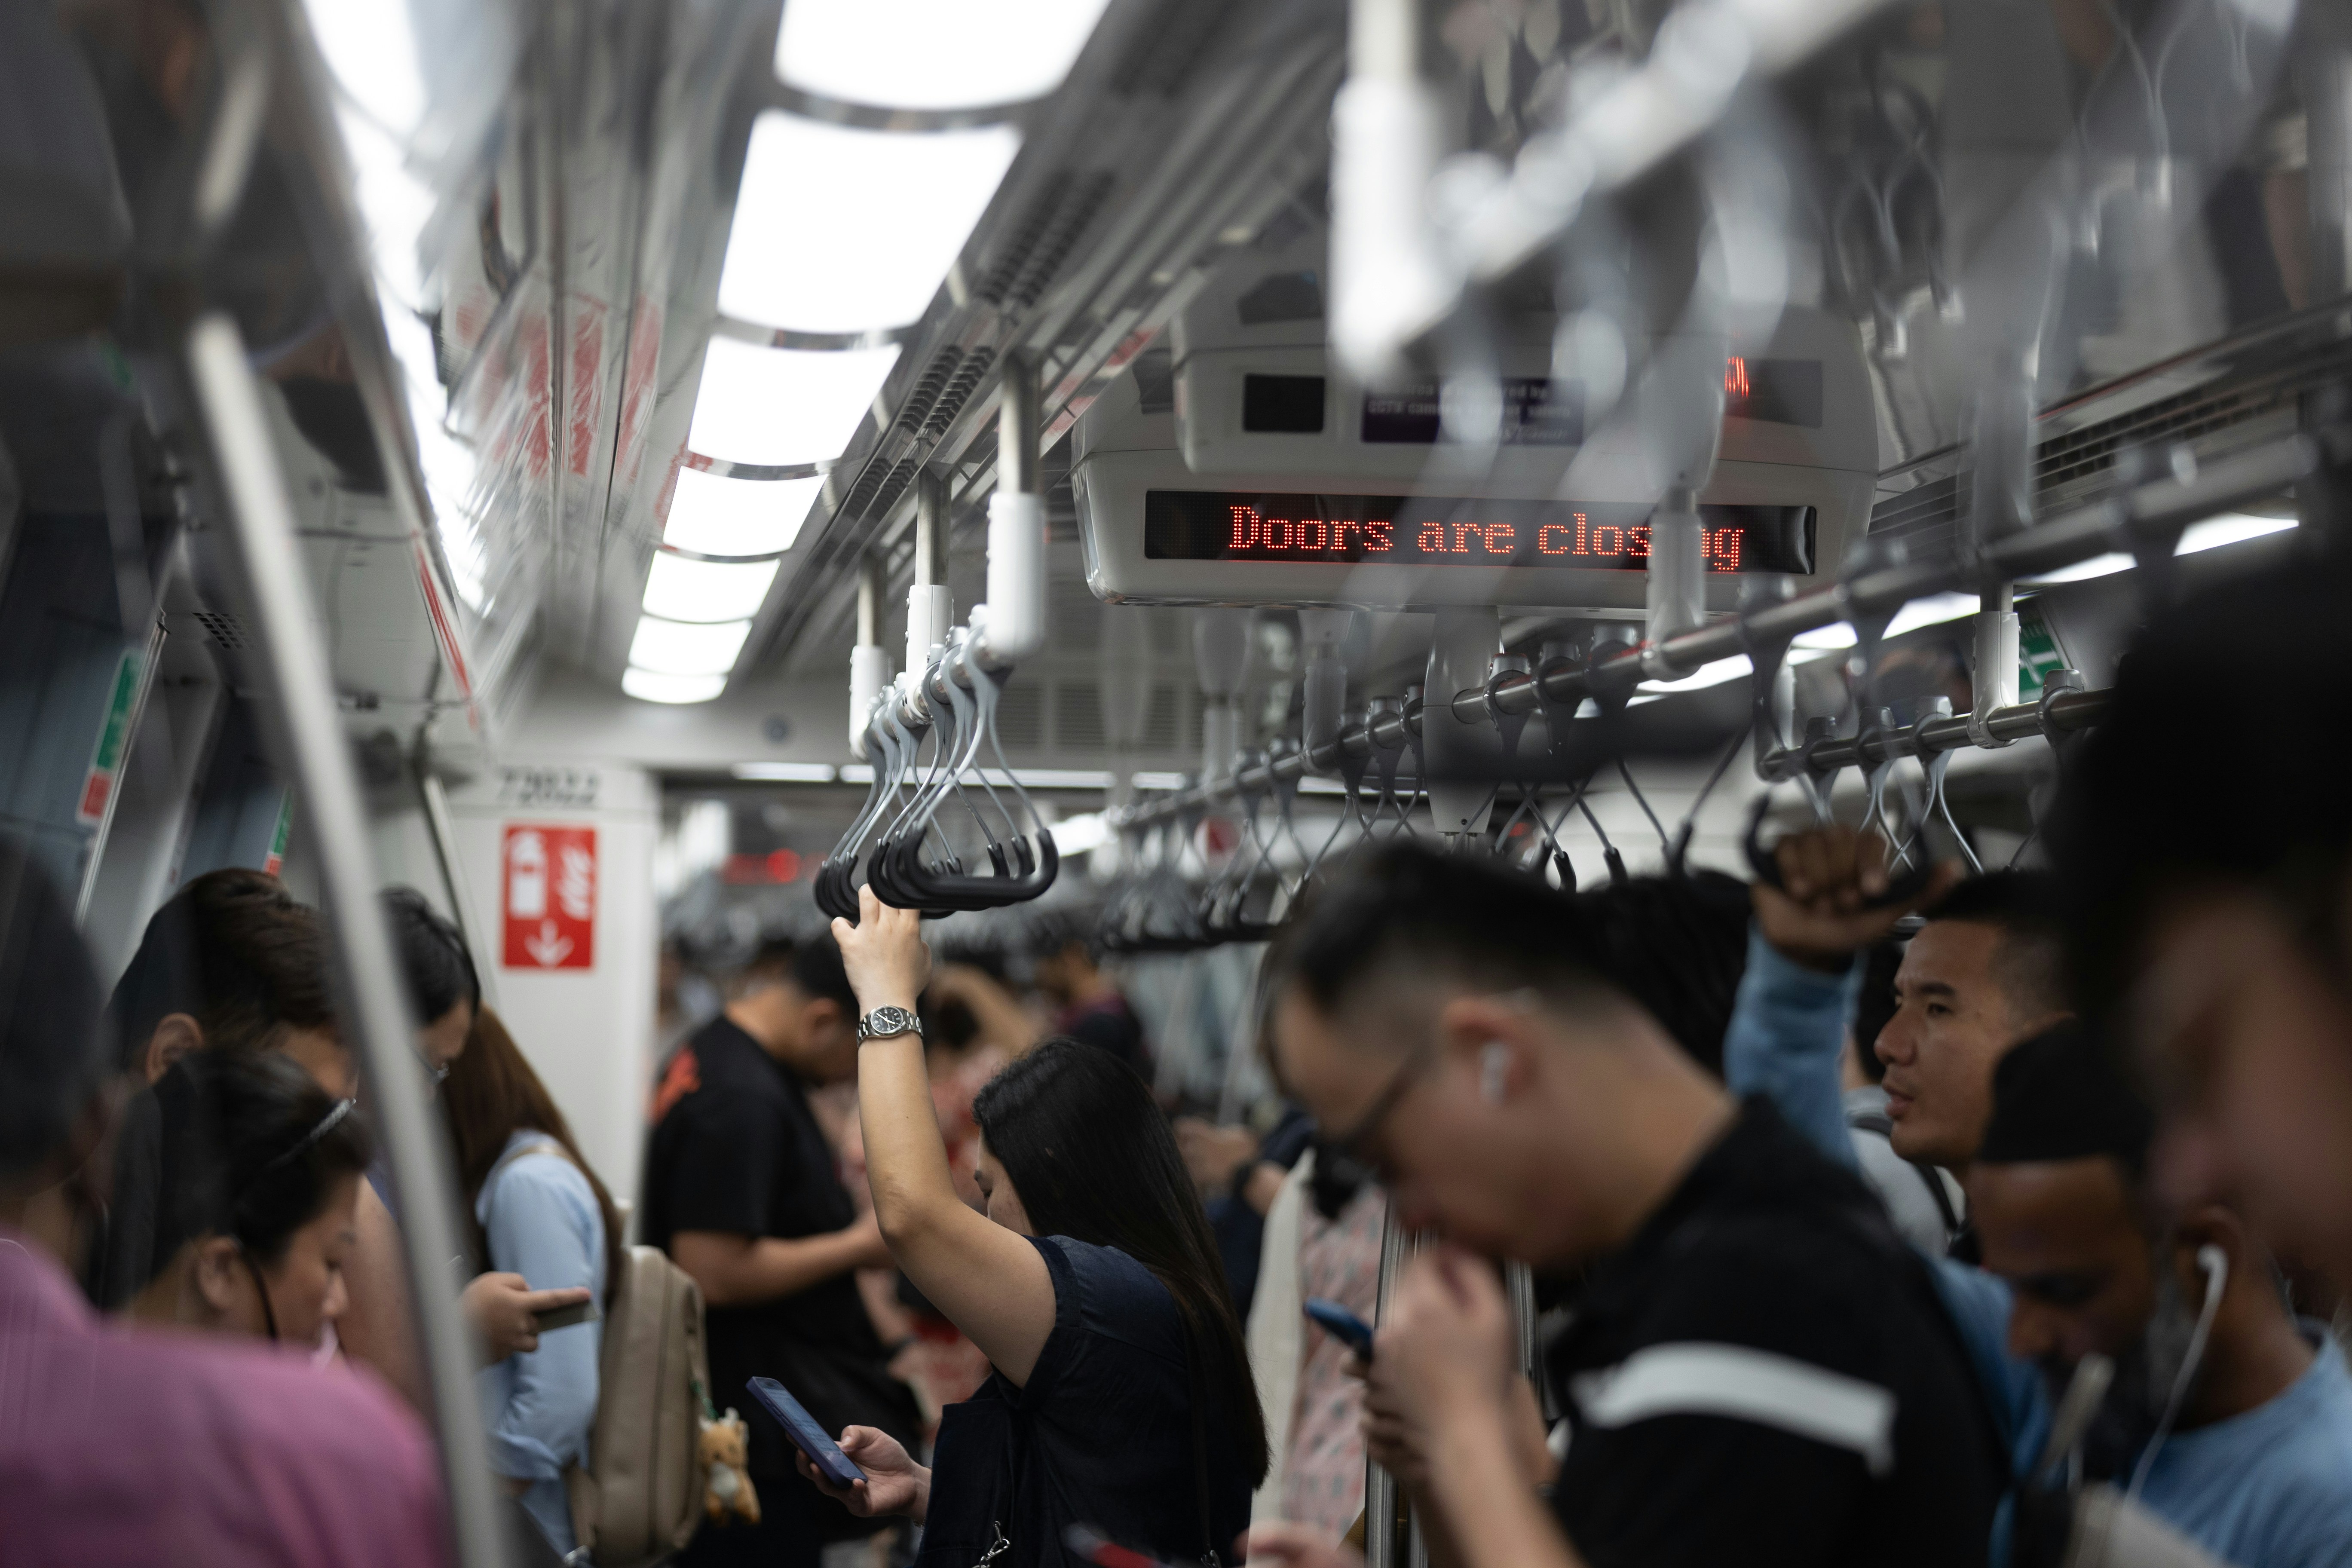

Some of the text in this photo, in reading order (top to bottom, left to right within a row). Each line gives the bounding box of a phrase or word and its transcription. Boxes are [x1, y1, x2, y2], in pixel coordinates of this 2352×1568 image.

[1229, 506, 1745, 571] Doors are closg
